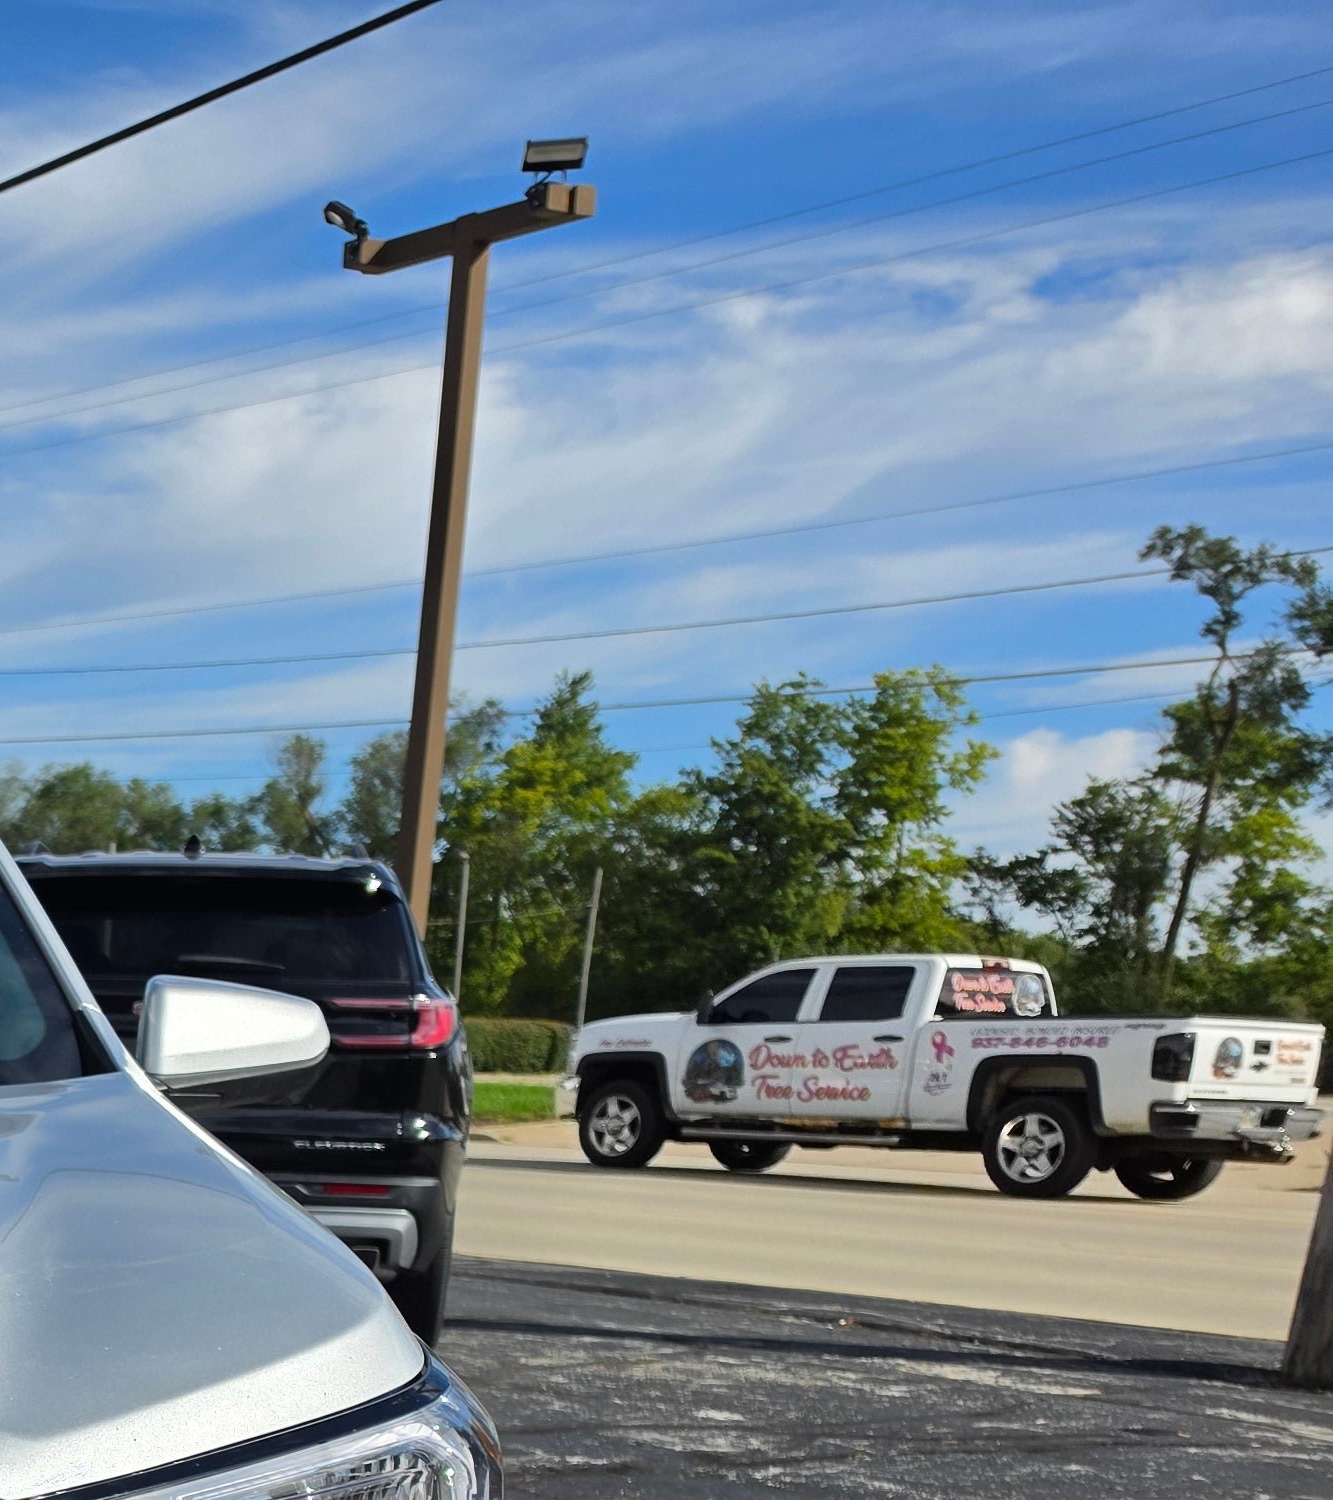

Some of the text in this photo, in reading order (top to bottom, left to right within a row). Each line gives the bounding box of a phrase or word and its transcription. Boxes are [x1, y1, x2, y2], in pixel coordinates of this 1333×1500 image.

[748, 1043, 899, 1072] Down to Earth
[751, 1074, 872, 1102] Tree Service
